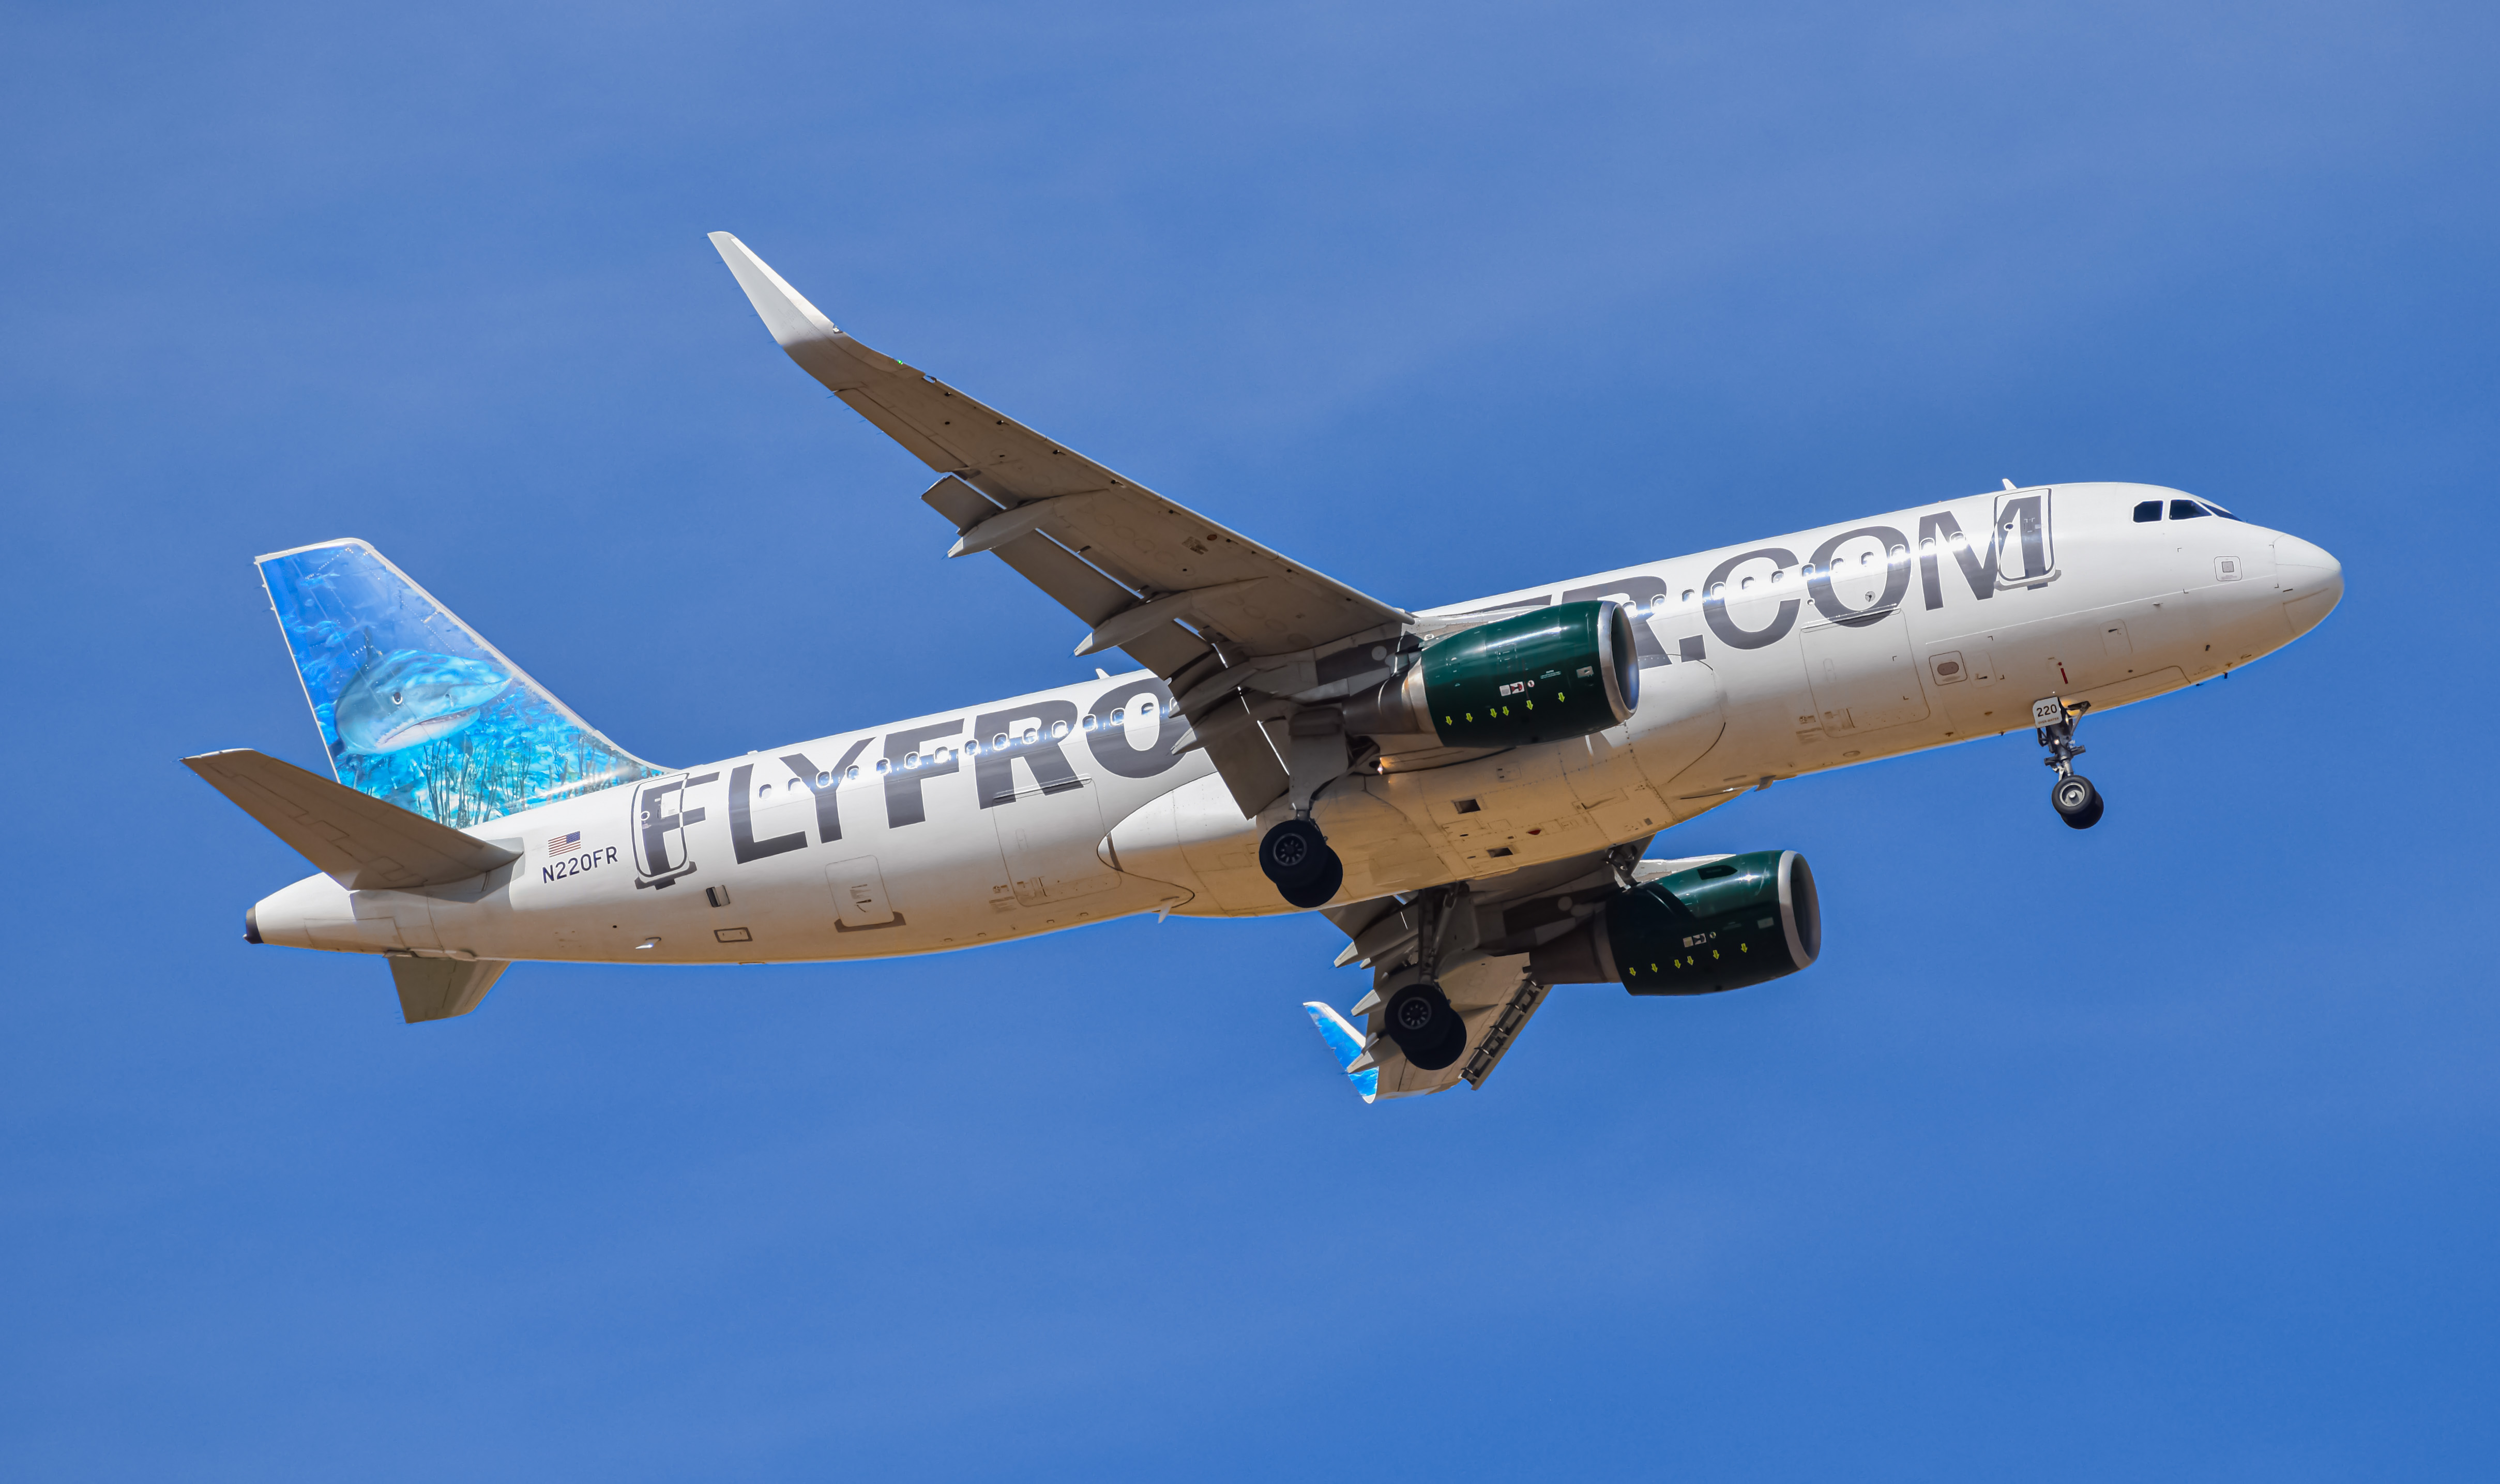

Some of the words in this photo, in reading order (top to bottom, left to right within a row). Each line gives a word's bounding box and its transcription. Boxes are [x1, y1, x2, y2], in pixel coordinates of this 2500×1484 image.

[642, 496, 2049, 889] FLYFROR.COM
[2036, 704, 2057, 717] 220
[542, 846, 618, 884] N220FR
